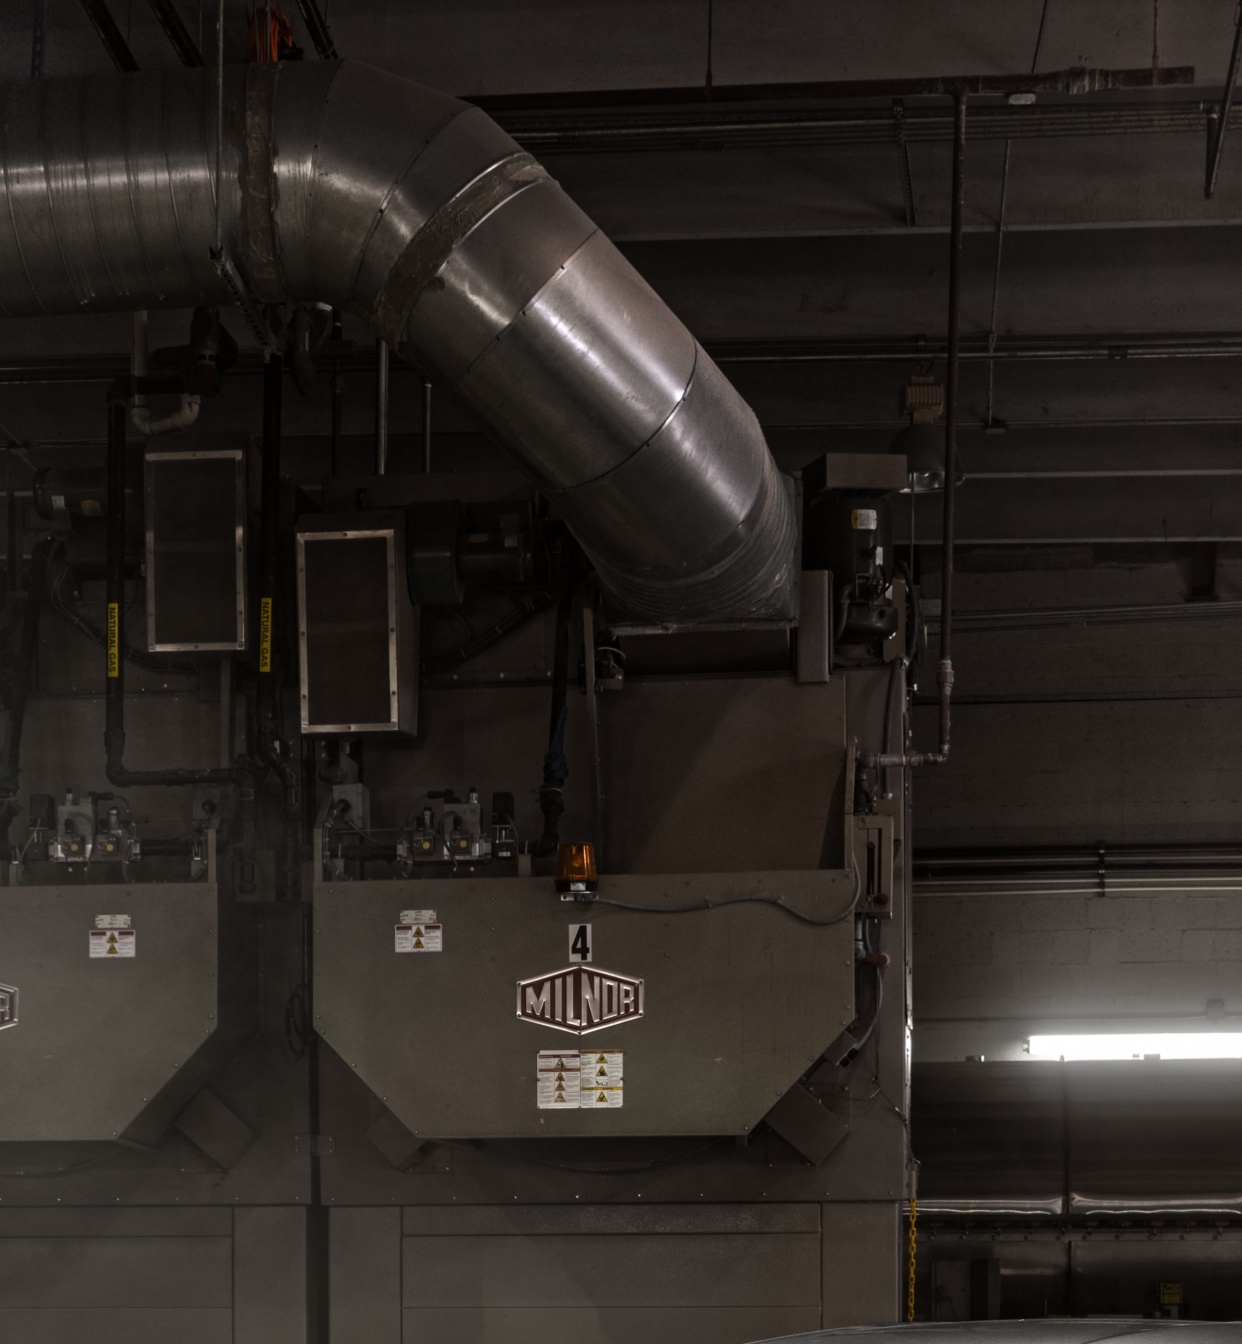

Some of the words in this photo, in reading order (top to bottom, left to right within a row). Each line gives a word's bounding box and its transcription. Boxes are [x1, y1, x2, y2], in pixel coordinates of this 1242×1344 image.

[262, 602, 270, 645] NATURAL
[261, 647, 269, 668] GAS
[571, 925, 590, 961] 4
[525, 971, 635, 1027] MILNOR
